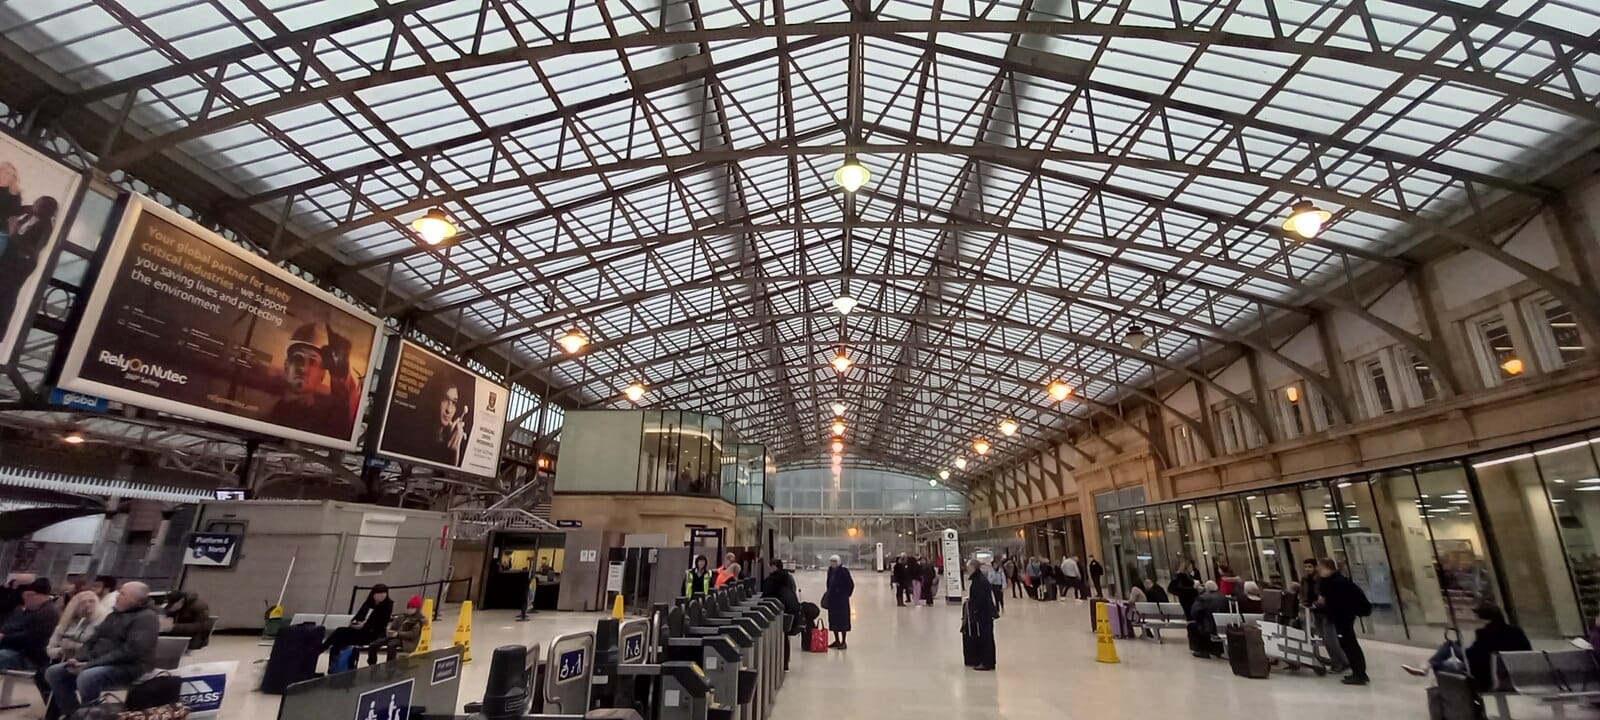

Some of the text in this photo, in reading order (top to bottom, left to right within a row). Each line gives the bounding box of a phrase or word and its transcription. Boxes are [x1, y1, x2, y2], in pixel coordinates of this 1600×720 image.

[141, 241, 182, 266] critical
[184, 261, 234, 290] industries
[240, 287, 255, 299] we
[256, 293, 288, 314] support
[149, 226, 291, 302] Your global partner for safety
[131, 269, 223, 314] the environment
[134, 255, 283, 326] you saving lives and protecting
[98, 350, 188, 384] RelyOn Nutec
[63, 393, 98, 407] global
[195, 536, 223, 545] Platform
